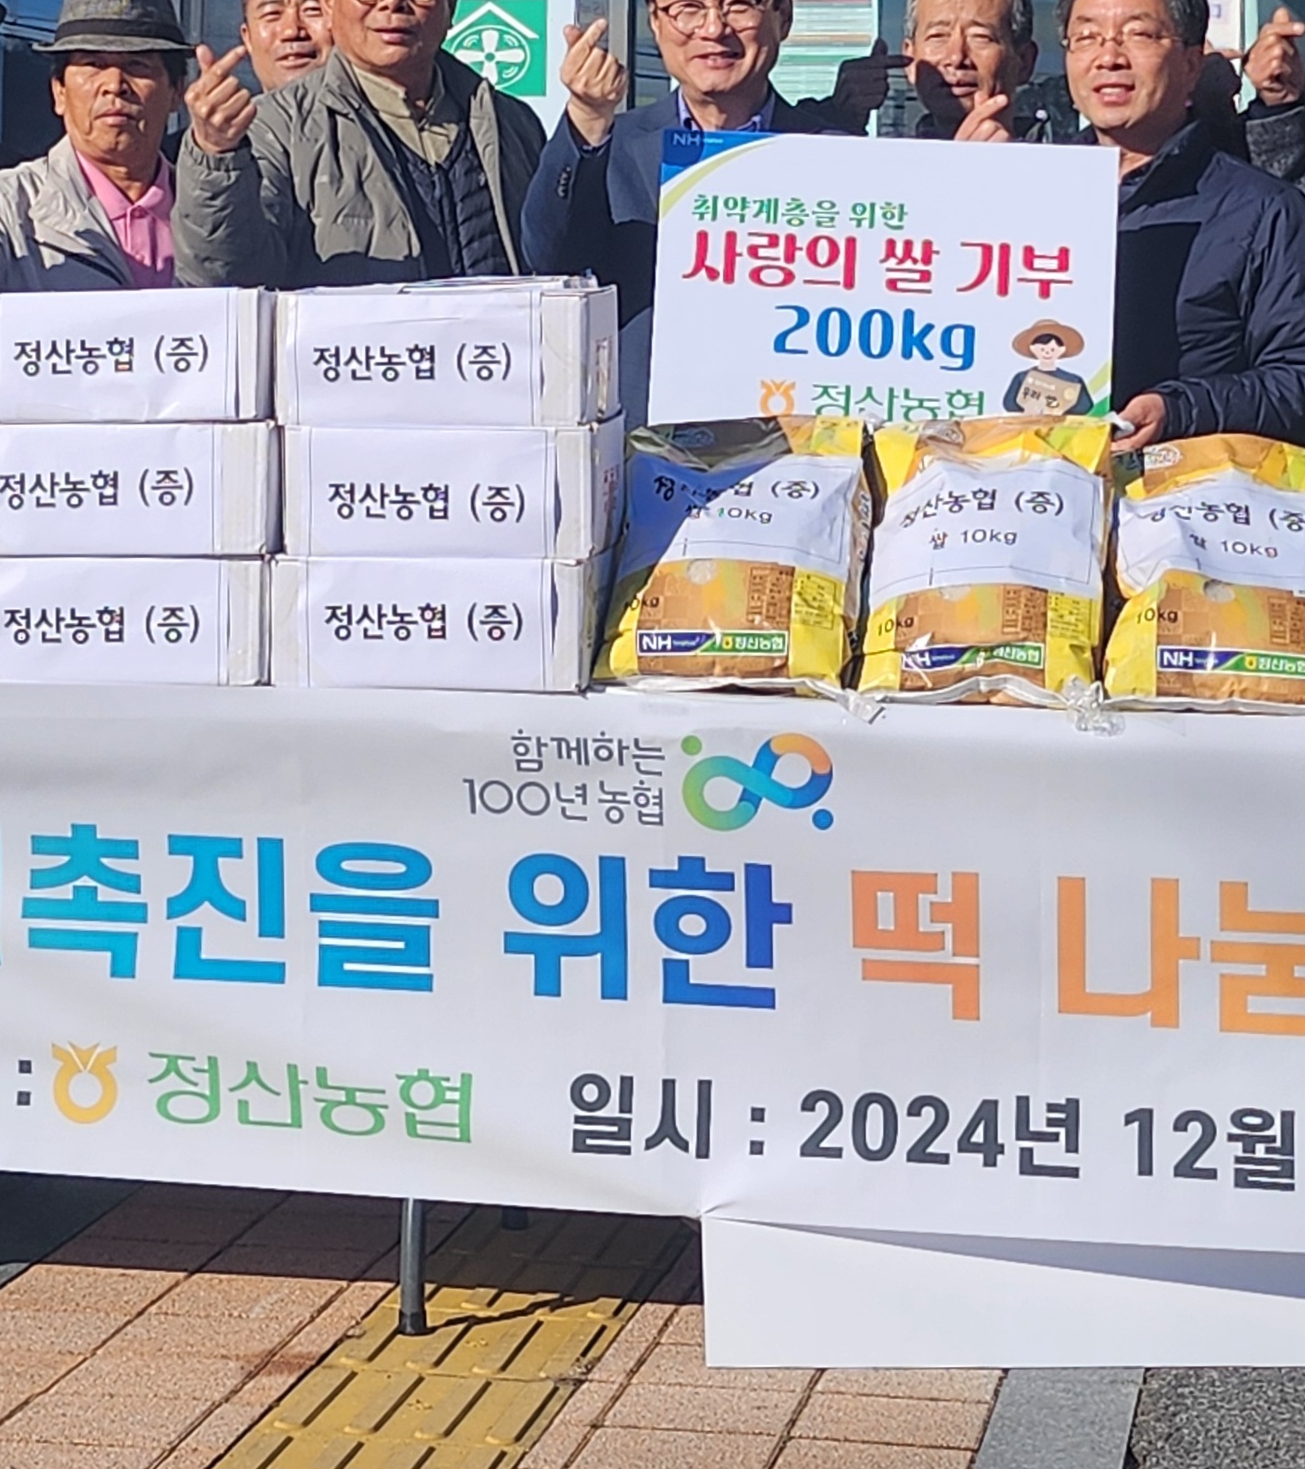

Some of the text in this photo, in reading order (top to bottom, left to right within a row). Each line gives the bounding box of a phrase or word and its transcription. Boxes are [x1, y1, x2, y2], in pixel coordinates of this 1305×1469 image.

[672, 133, 701, 145] NH
[692, 194, 908, 230] 취약계층을 위한
[682, 229, 1074, 300] 사랑의 쌀 기부
[13, 335, 210, 376] 정산농협 (증)
[772, 304, 976, 372] 200kg
[312, 343, 512, 382] 정산농협 (증)
[138, 468, 194, 507] (증)
[328, 483, 526, 522] 정산농협 (증)
[771, 481, 819, 499] (증)
[1014, 491, 1064, 516] (증)
[718, 507, 772, 524] 10kg
[961, 528, 1017, 545] 10kg
[1221, 540, 1278, 559] 10kg
[3, 605, 200, 645] 정산농협 (증)
[324, 603, 524, 642] 정산농협 (증)
[878, 616, 915, 637] 10kg
[1137, 608, 1179, 624] 10kg
[642, 635, 672, 650] NH
[1162, 651, 1194, 666] NH
[511, 728, 665, 776] 함께하는
[462, 778, 664, 827] 100년 농협
[503, 852, 793, 1011] 위한
[850, 868, 981, 1022] 떡
[147, 1051, 474, 1143] 정산농협
[569, 1073, 712, 1160] 일시
[800, 1088, 1082, 1179] 2024년
[1123, 1106, 1297, 1192] 12월
